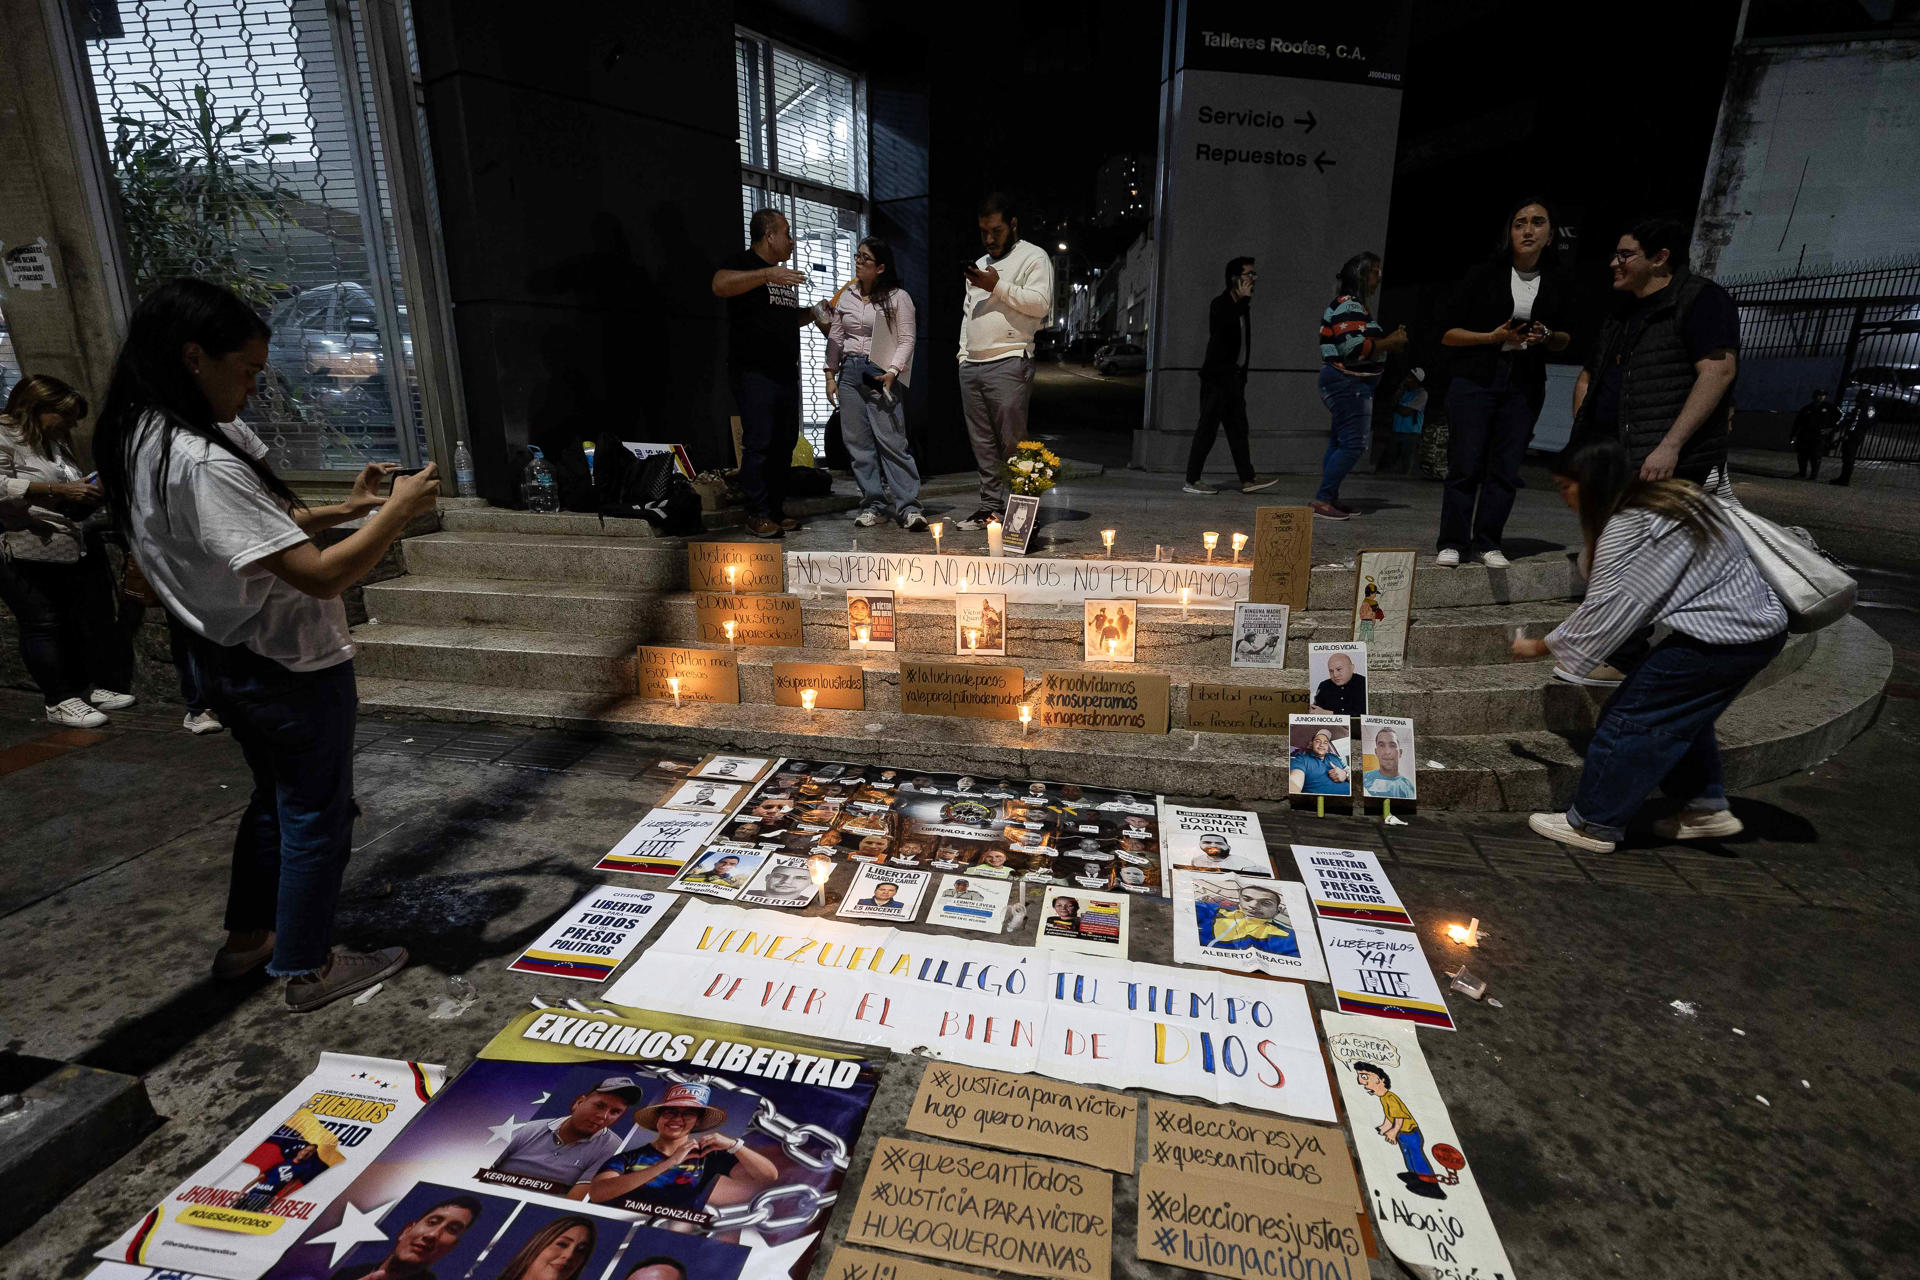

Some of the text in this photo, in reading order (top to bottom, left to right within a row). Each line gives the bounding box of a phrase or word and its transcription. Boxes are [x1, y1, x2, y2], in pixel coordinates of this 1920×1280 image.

[1201, 31, 1367, 61] Talleres Rootes, C.A.
[1197, 105, 1285, 129] Servicio
[1195, 143, 1308, 167] Repuestos
[797, 554, 822, 586] NO
[932, 558, 958, 587] NO
[1073, 565, 1100, 593] NO
[1103, 564, 1240, 599] PERDONAMOS
[1313, 644, 1340, 652] CARLOS
[1179, 816, 1247, 828] JOSNAR
[1180, 823, 1249, 836] BADUEL
[716, 847, 761, 857] LIBERTAD
[1310, 856, 1368, 870] LIBERTAD
[864, 873, 894, 883] RICARDO
[867, 865, 921, 880] LIBERTAD
[1314, 868, 1374, 882] TODOS
[1320, 880, 1381, 895] PRESOS
[741, 893, 808, 906] LIBERTAD
[1324, 890, 1386, 904] POLÍTICOS
[590, 899, 653, 915] LIBERTAD
[864, 906, 902, 914] INOCENTE
[578, 912, 640, 930] TODOS
[560, 926, 627, 945] PRESOS
[548, 938, 615, 956] POLÍTICOS
[1329, 936, 1415, 953] ¡LIBÉRENLOS
[1201, 949, 1302, 967] ALBERTO BRACHO
[1355, 949, 1396, 970] YA!
[696, 925, 912, 977] VENEZUELA
[1047, 971, 1103, 1005] TU
[1118, 980, 1274, 1029] TIEMPO
[702, 972, 1286, 1089] DE VER EL BIEN DE DIOS
[522, 1012, 861, 1090] EXIGIMOS LIBERTAD
[1352, 1038, 1391, 1052] ESPERA
[309, 1092, 396, 1124] EXIGIMOS
[483, 1170, 553, 1191] KERVIN EPIEYU
[624, 1199, 708, 1223] TAINA GONZÁLEZ
